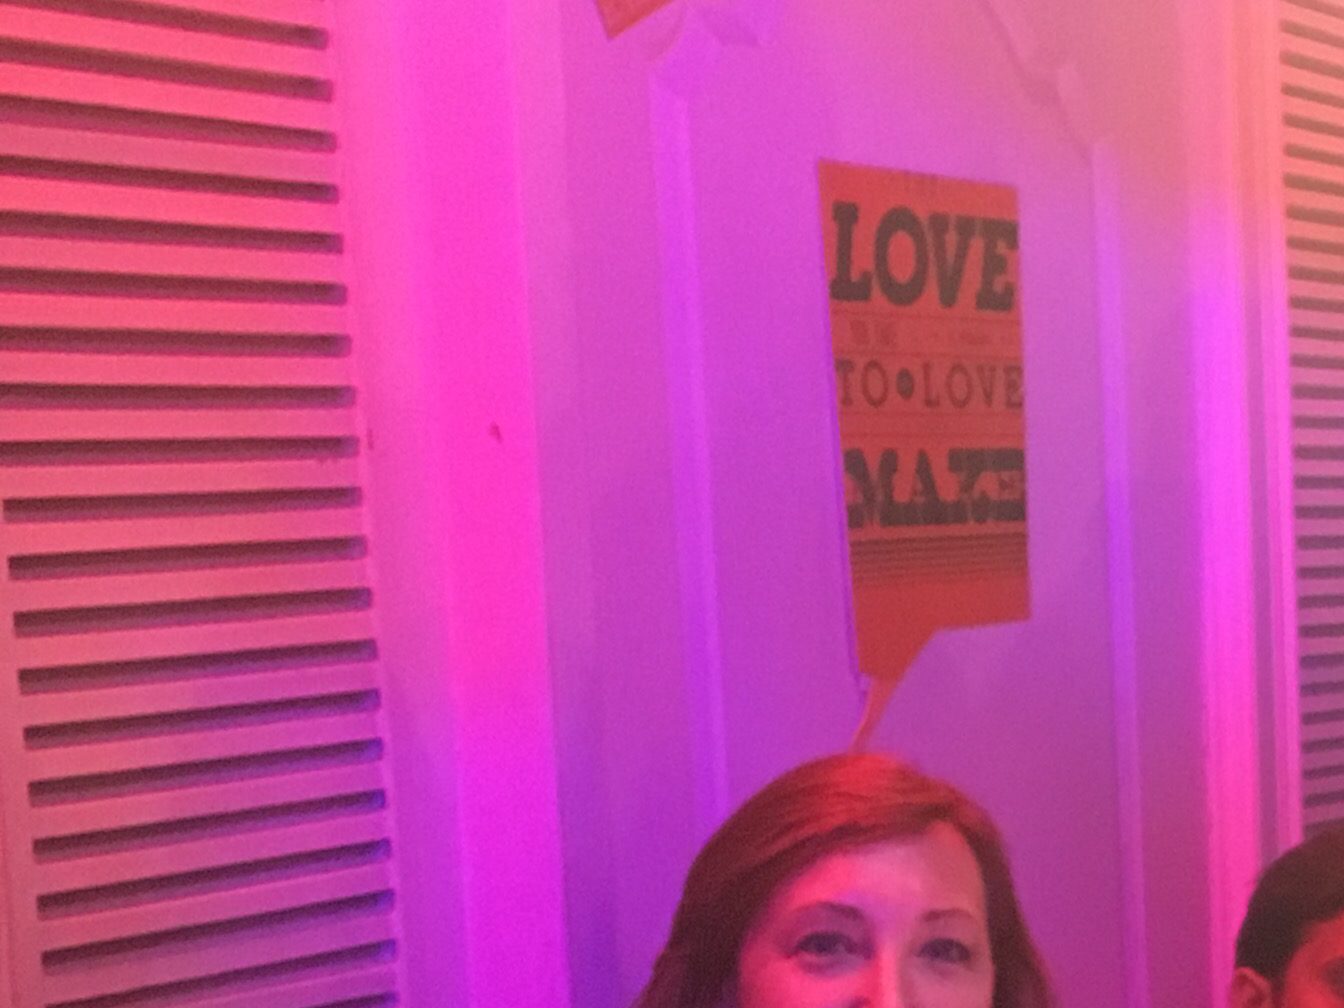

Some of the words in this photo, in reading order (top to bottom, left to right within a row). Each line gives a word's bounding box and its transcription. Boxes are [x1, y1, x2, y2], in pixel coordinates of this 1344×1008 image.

[830, 200, 1019, 311] LOVE
[835, 358, 888, 408] TO
[922, 361, 1025, 409] LOVE
[842, 447, 1027, 529] MAKE
